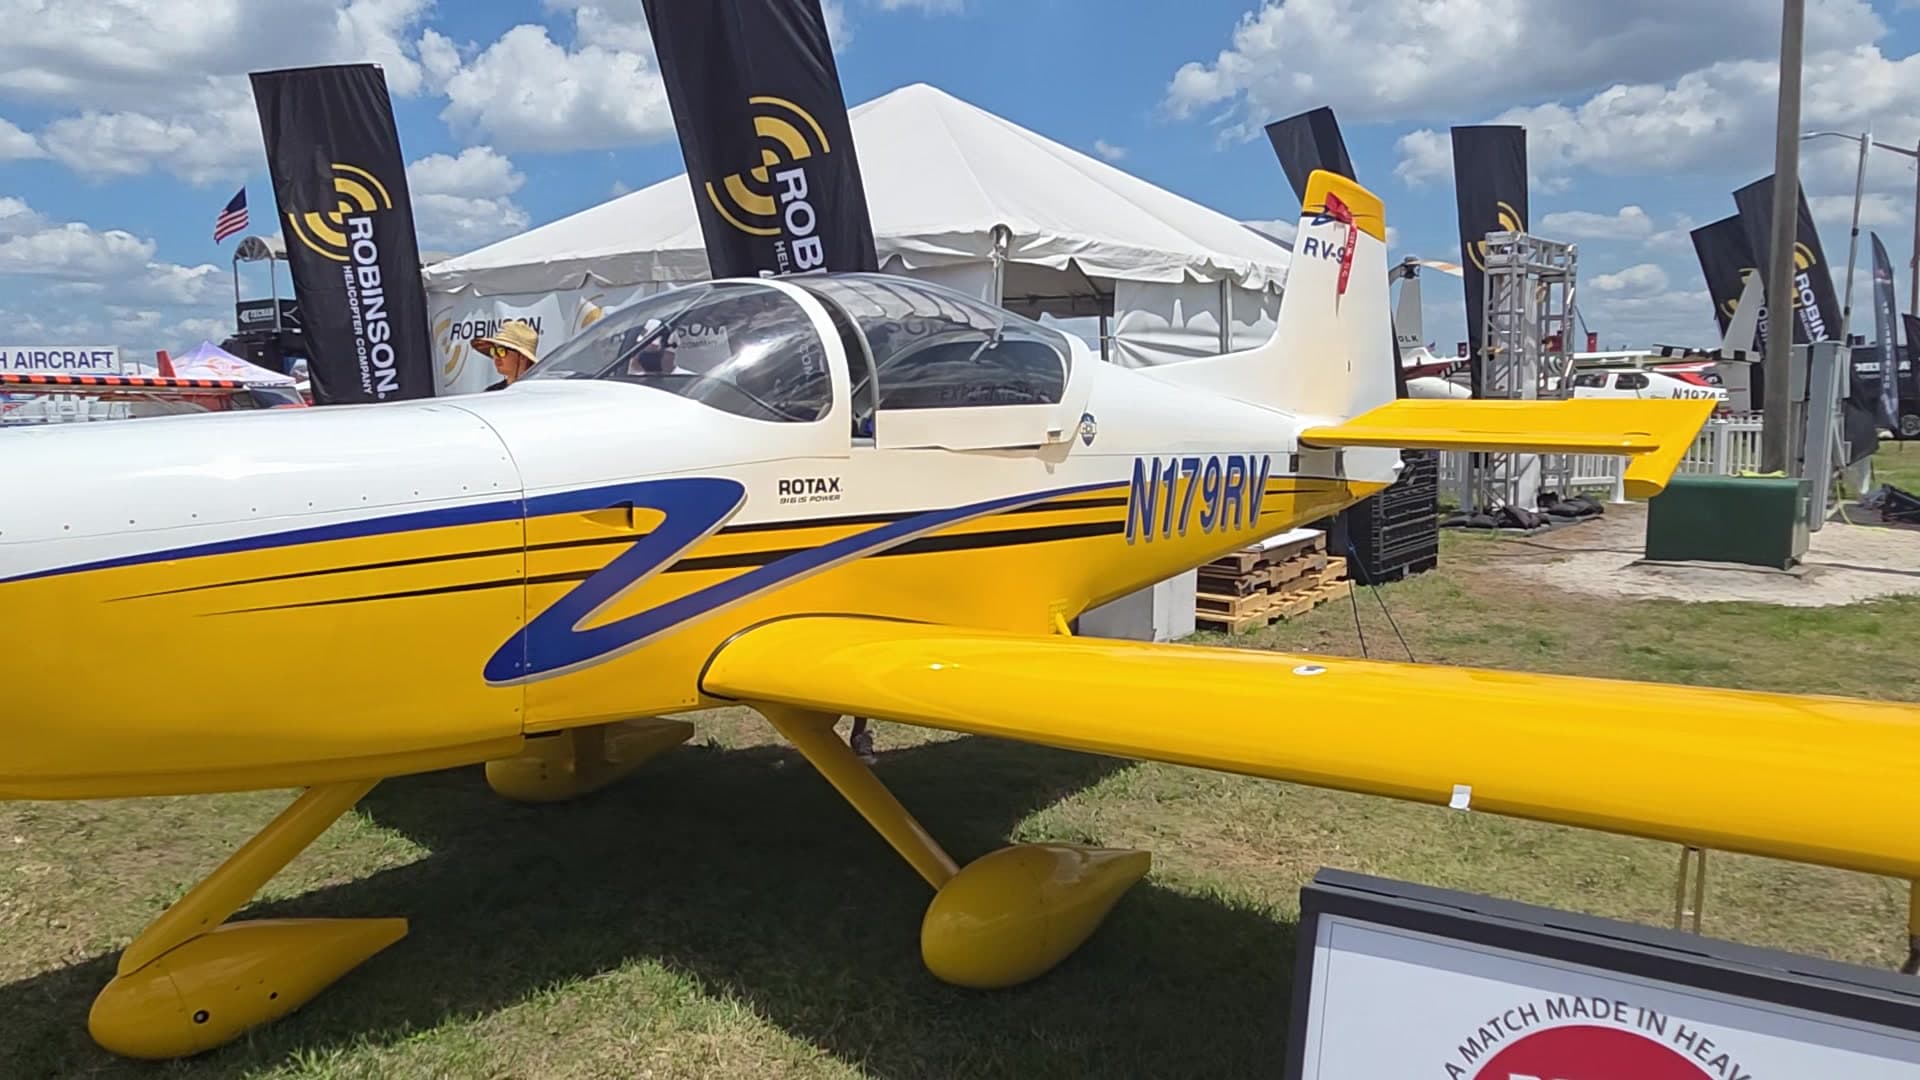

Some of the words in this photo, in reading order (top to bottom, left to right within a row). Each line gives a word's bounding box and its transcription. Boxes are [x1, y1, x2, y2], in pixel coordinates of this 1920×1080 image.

[342, 265, 363, 336] HELICOPTER
[355, 337, 373, 395] COMPANY
[348, 216, 399, 393] ROBINSON
[14, 351, 114, 369] AIRCRAFT
[779, 477, 840, 495] ROTAX
[1126, 455, 1271, 545] N179RV
[1444, 1062, 1466, 1080] A
[1458, 1002, 1540, 1065] MATCH
[1545, 996, 1629, 1024] MADE
[1636, 1006, 1668, 1036] IN
